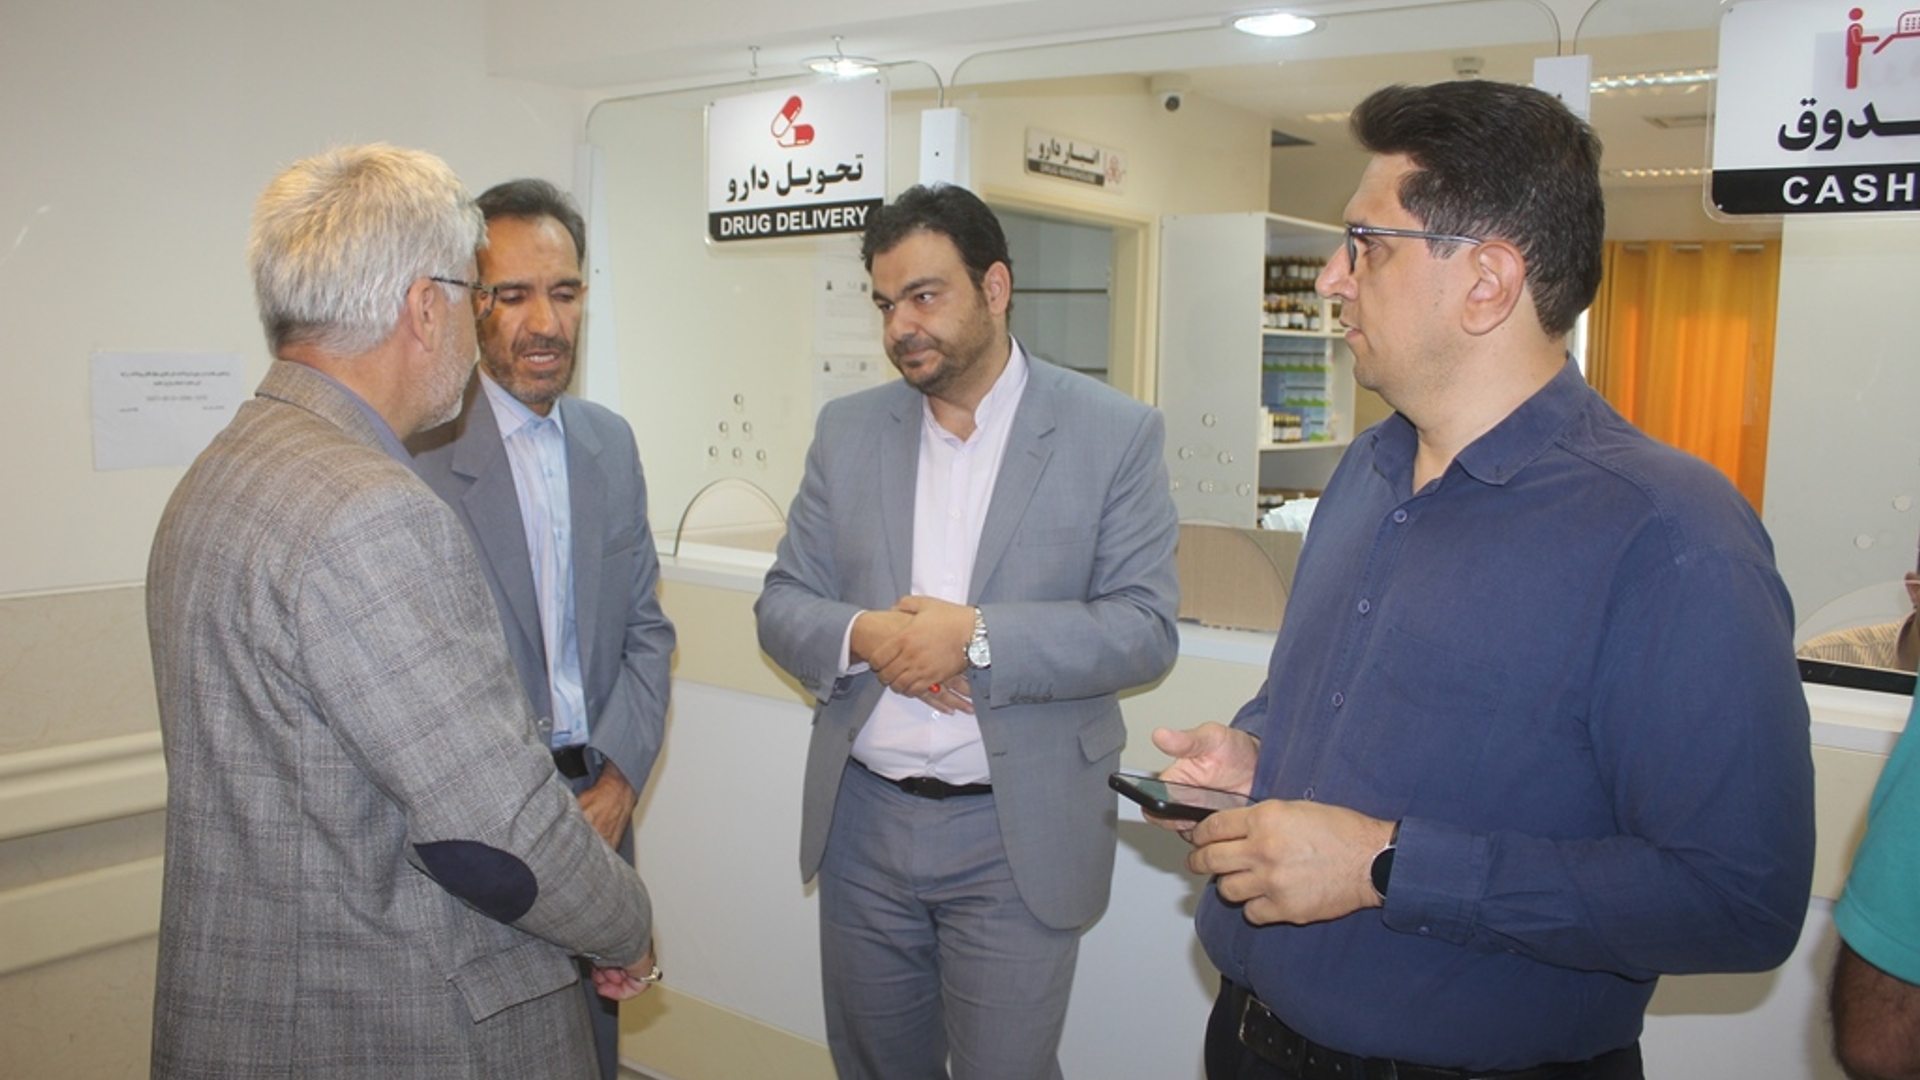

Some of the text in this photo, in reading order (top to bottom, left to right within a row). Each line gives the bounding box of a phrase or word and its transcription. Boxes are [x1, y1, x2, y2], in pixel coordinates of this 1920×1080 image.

[1778, 98, 1920, 151] دوق
[1039, 138, 1100, 166] انبار دارو
[726, 154, 864, 202] تحویل دارو
[721, 206, 869, 236] DRUG DELIVERY
